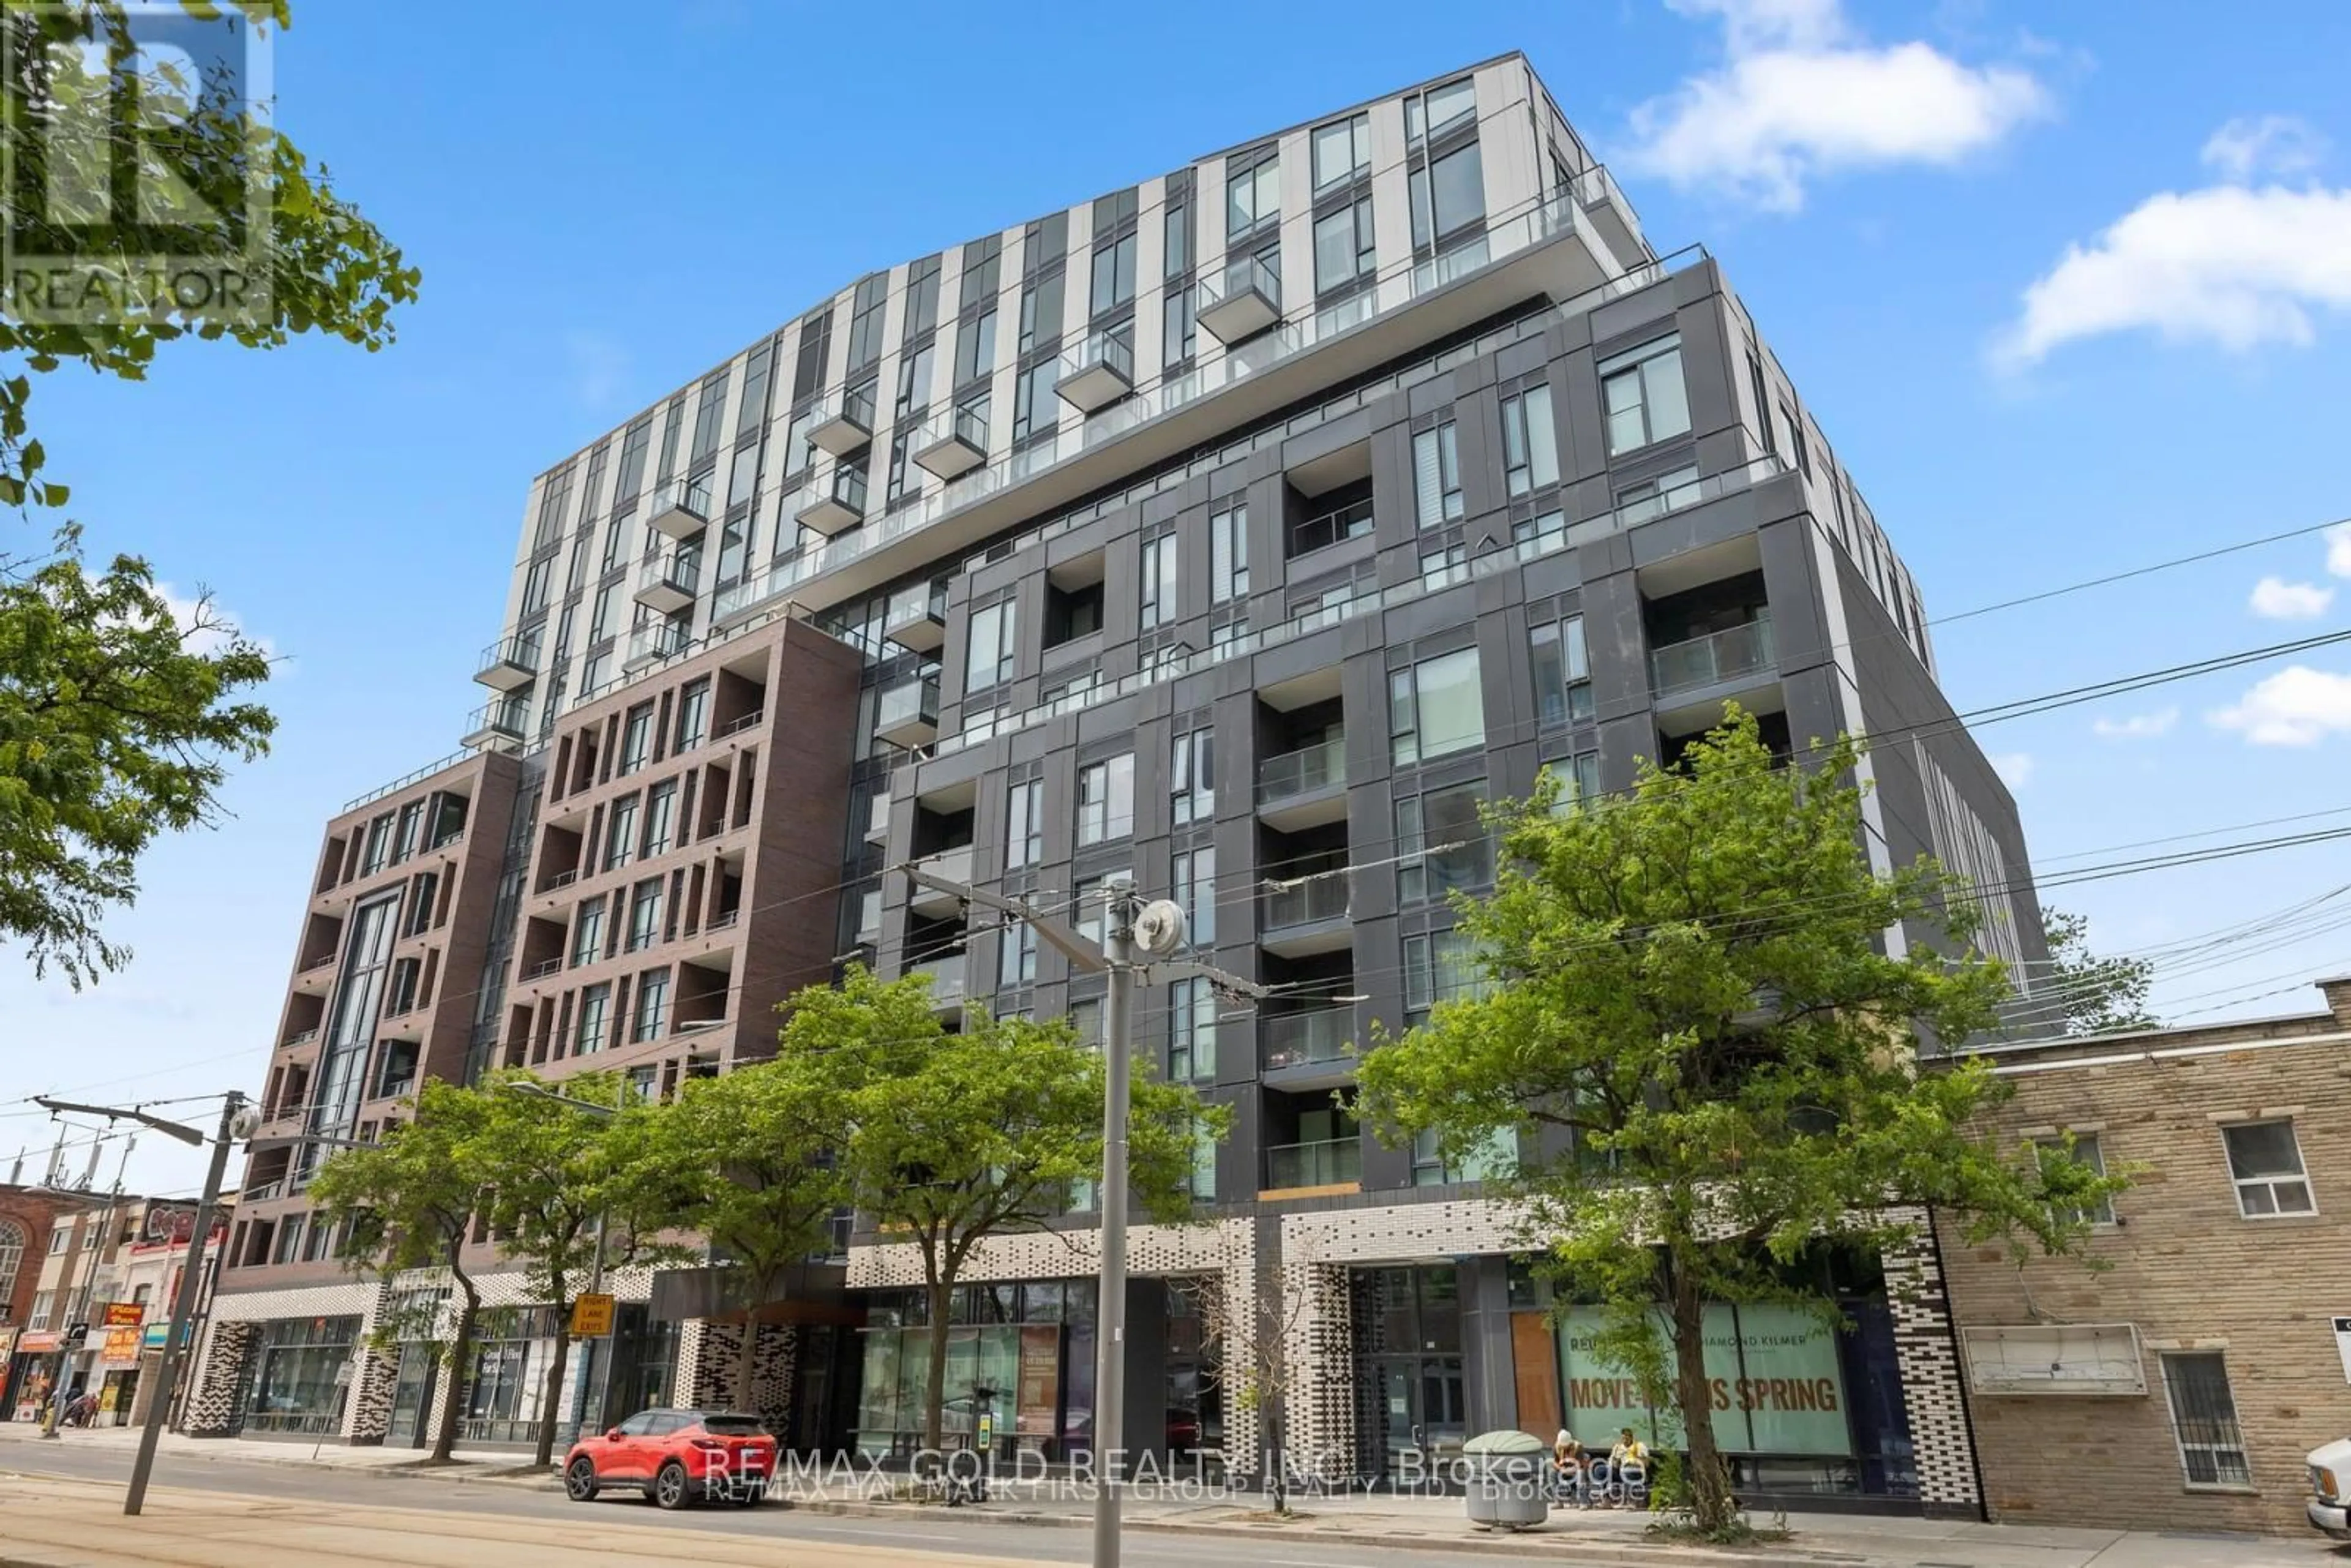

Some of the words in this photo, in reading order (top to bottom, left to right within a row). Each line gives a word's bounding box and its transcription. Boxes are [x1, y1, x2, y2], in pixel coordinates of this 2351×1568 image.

[582, 1310, 603, 1318] LANE
[1703, 1335, 1758, 1347] IAMOND
[1761, 1334, 1806, 1346] KILMER
[1734, 1376, 1838, 1412] SPRING
